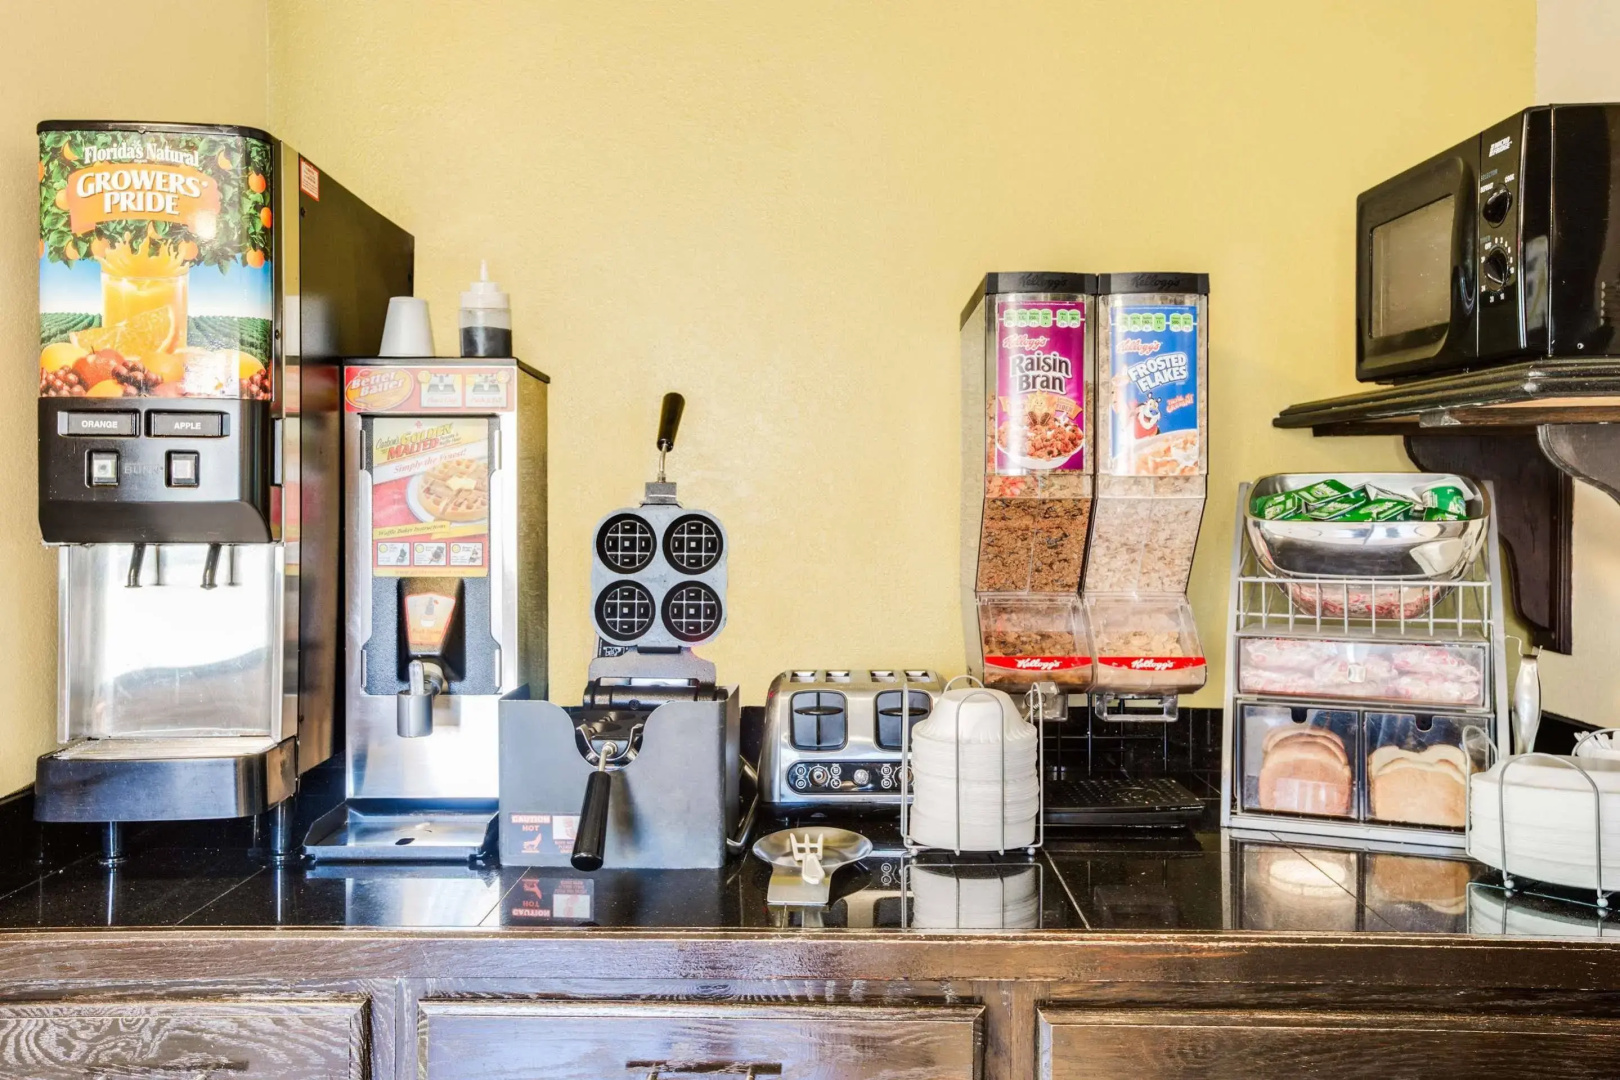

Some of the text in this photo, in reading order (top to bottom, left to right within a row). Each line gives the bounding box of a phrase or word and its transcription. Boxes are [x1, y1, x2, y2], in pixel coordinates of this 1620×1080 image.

[84, 141, 200, 167] Florida's Natural
[104, 191, 180, 215] PRIDE
[1018, 274, 1068, 289] Kellogg's
[1130, 274, 1184, 289] Kellogg's
[1002, 334, 1048, 351] Kellogg's
[1116, 338, 1162, 355] Kellogg's
[1010, 351, 1071, 377] Raisin
[1127, 353, 1187, 382] FROSTED
[1018, 373, 1065, 393] Bran
[1137, 366, 1188, 393] FLAKES
[81, 419, 118, 429] ORANGE
[173, 421, 202, 430] APPLE
[400, 422, 453, 446] GOLDEN
[387, 437, 440, 460] MALTED
[1016, 658, 1062, 670] Kellogg's
[1131, 658, 1175, 670] Kellogg's
[522, 824, 540, 832] HOT
